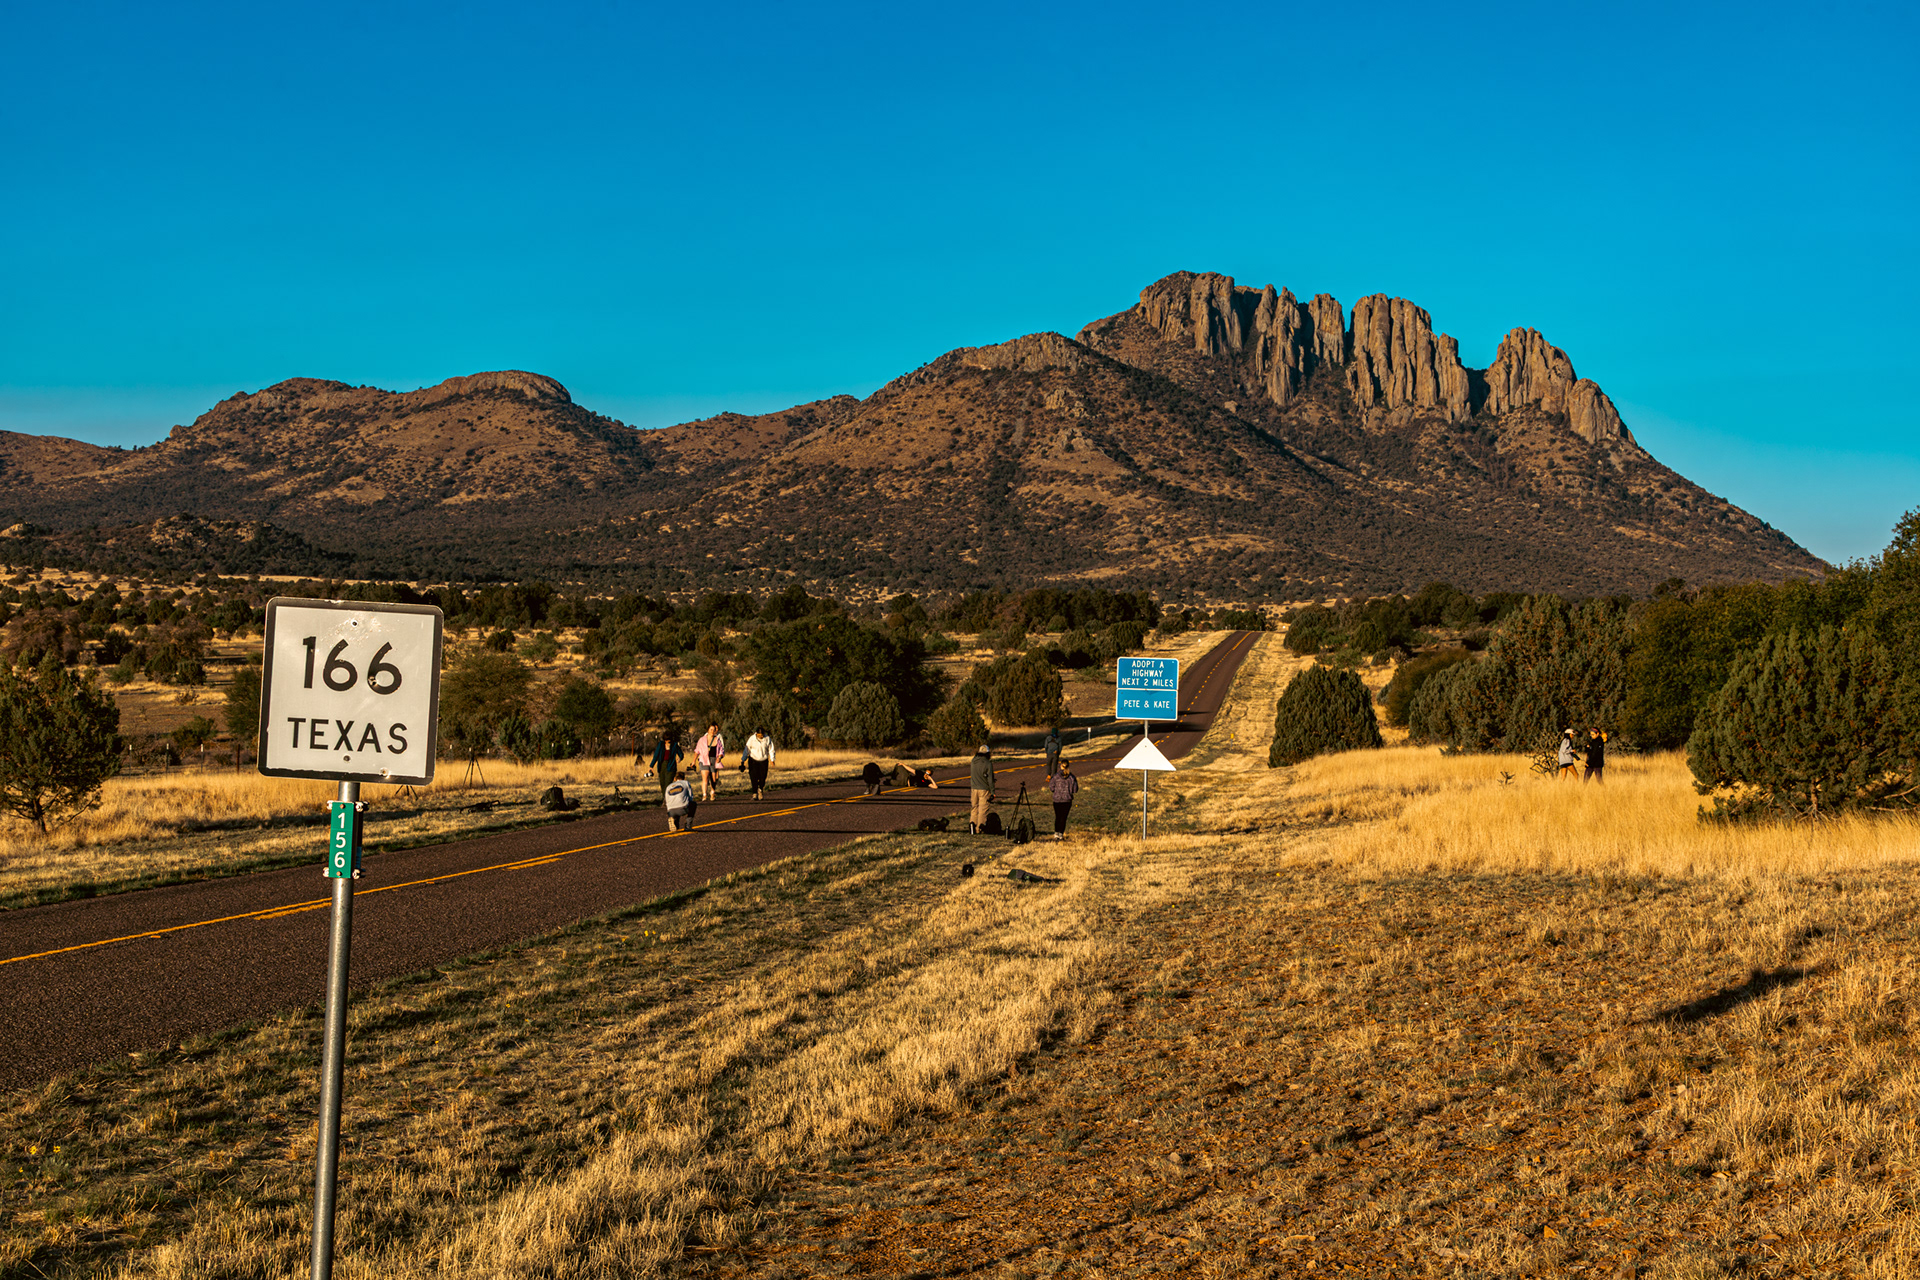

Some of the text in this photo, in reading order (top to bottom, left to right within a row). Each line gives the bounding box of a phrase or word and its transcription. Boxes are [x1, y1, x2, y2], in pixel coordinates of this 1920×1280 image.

[302, 636, 402, 695] 166
[1152, 679, 1174, 687] MILES
[287, 717, 408, 754] TEXAS
[334, 812, 346, 868] 156
